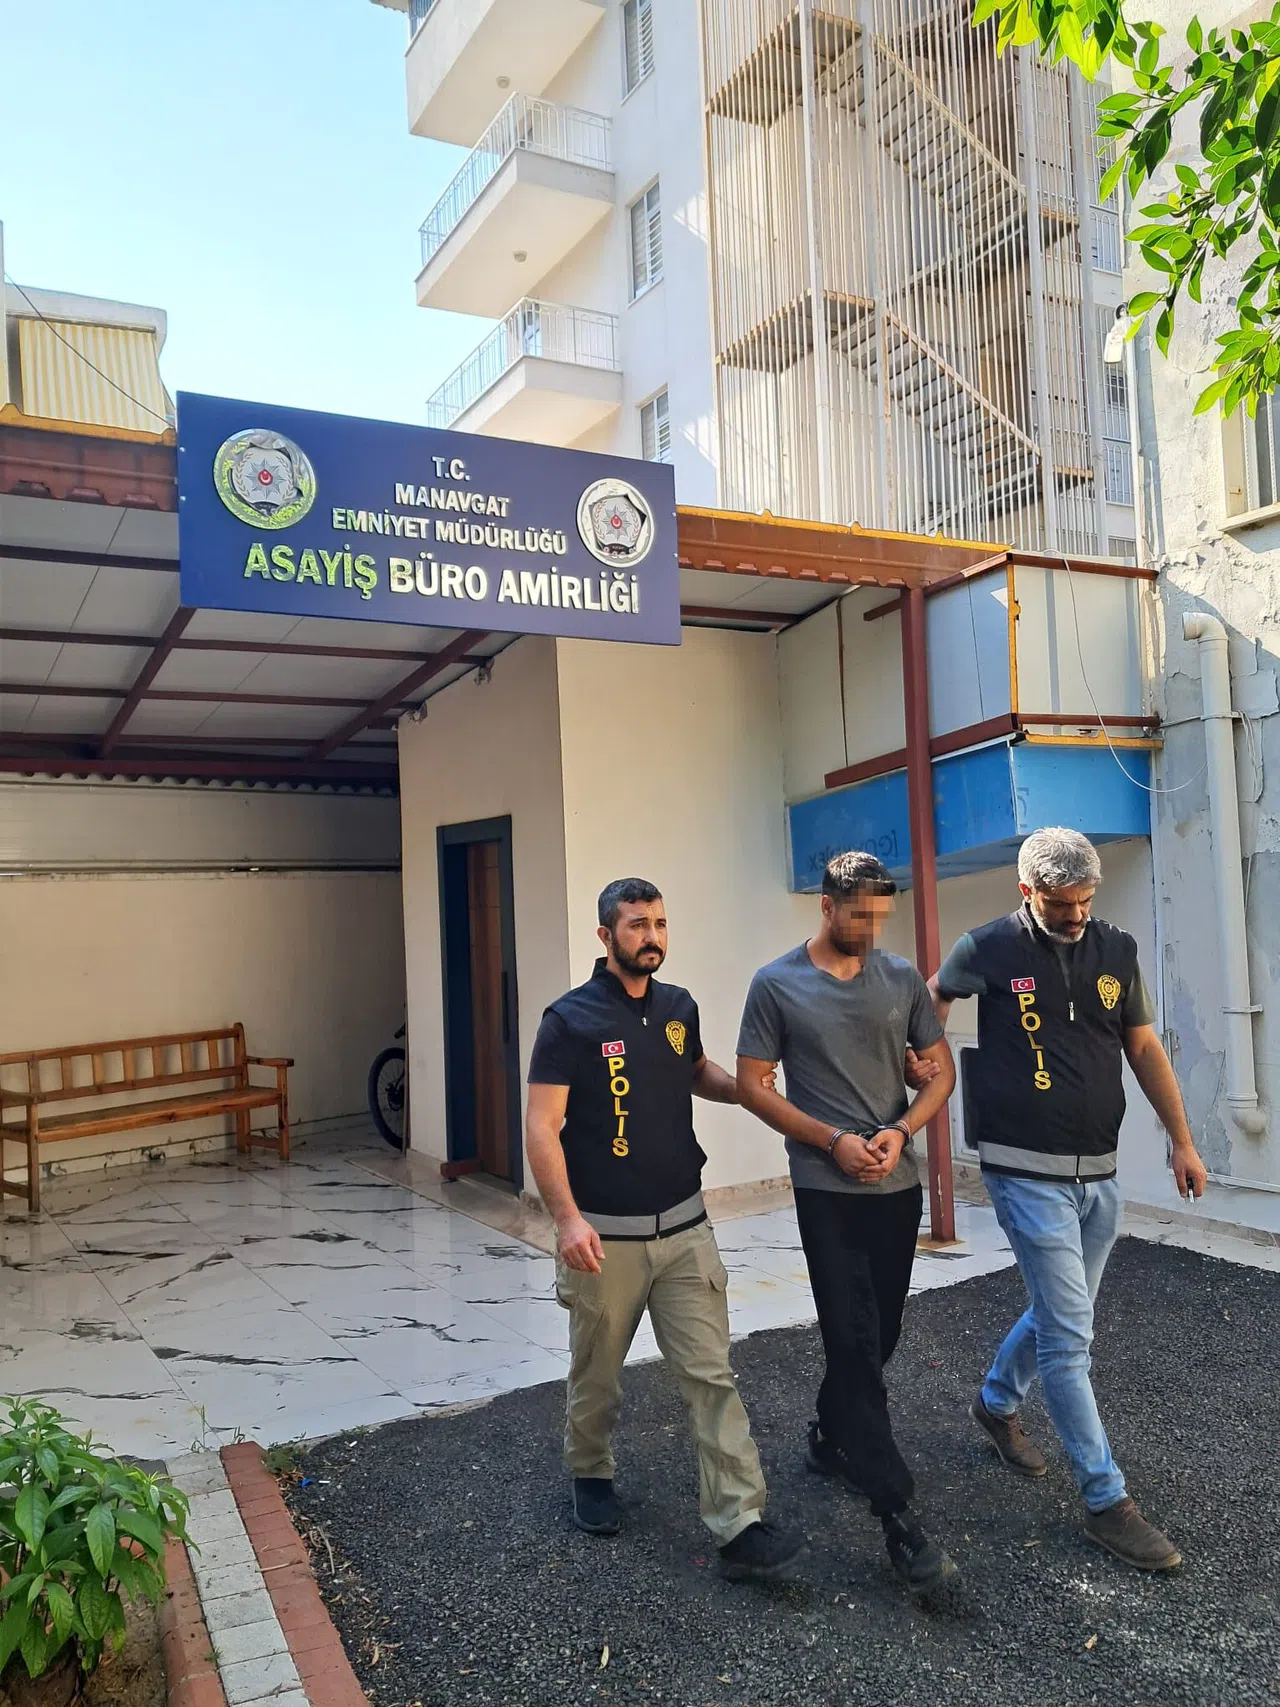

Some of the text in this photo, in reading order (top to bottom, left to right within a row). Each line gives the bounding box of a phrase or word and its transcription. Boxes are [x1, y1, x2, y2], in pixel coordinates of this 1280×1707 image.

[431, 456, 471, 481] T.C.
[395, 482, 510, 518] MANAVGAT
[332, 508, 568, 555] EMNİYET MÜDÜRLÜĞÜ
[244, 542, 640, 614] ASAYİŞ BÜRO AMİRLİĞİ
